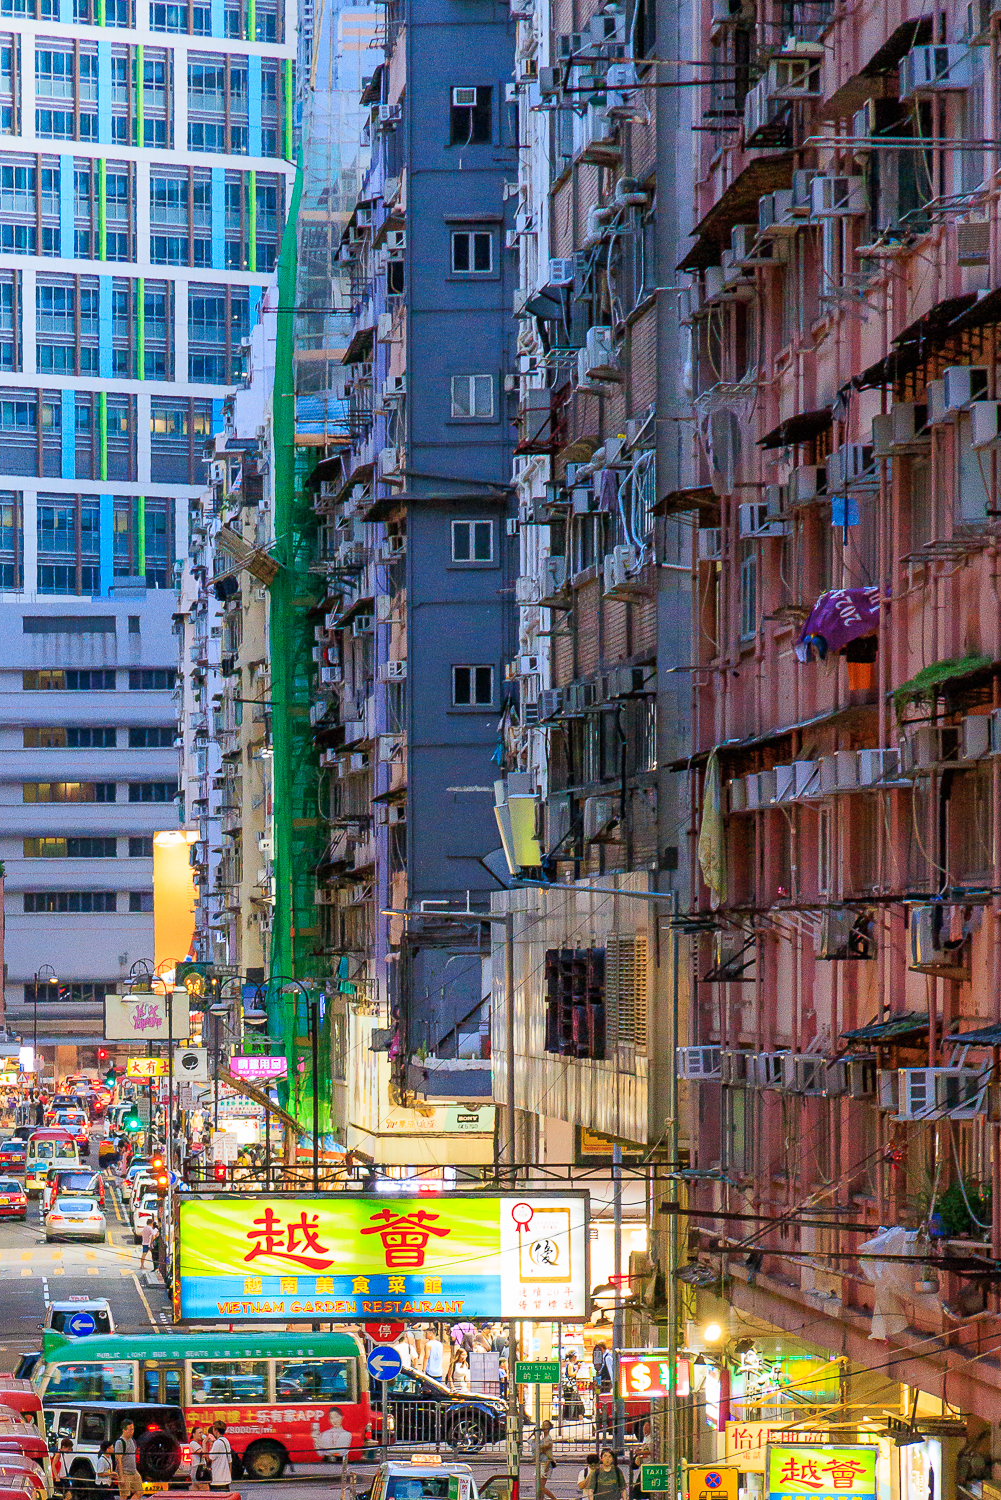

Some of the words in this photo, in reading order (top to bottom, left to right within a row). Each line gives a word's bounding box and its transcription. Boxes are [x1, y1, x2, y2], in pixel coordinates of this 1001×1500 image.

[243, 1207, 452, 1271] 越薈
[242, 1275, 444, 1295] 越南美食菜館
[217, 1300, 285, 1315] VIETNAM
[289, 1299, 357, 1314] GARDEN
[362, 1299, 466, 1315] RESTAURANT
[377, 1323, 393, 1339] 停
[523, 1372, 552, 1380] 的士站
[414, 1454, 440, 1462] TAXI
[779, 1457, 867, 1489] 越薈
